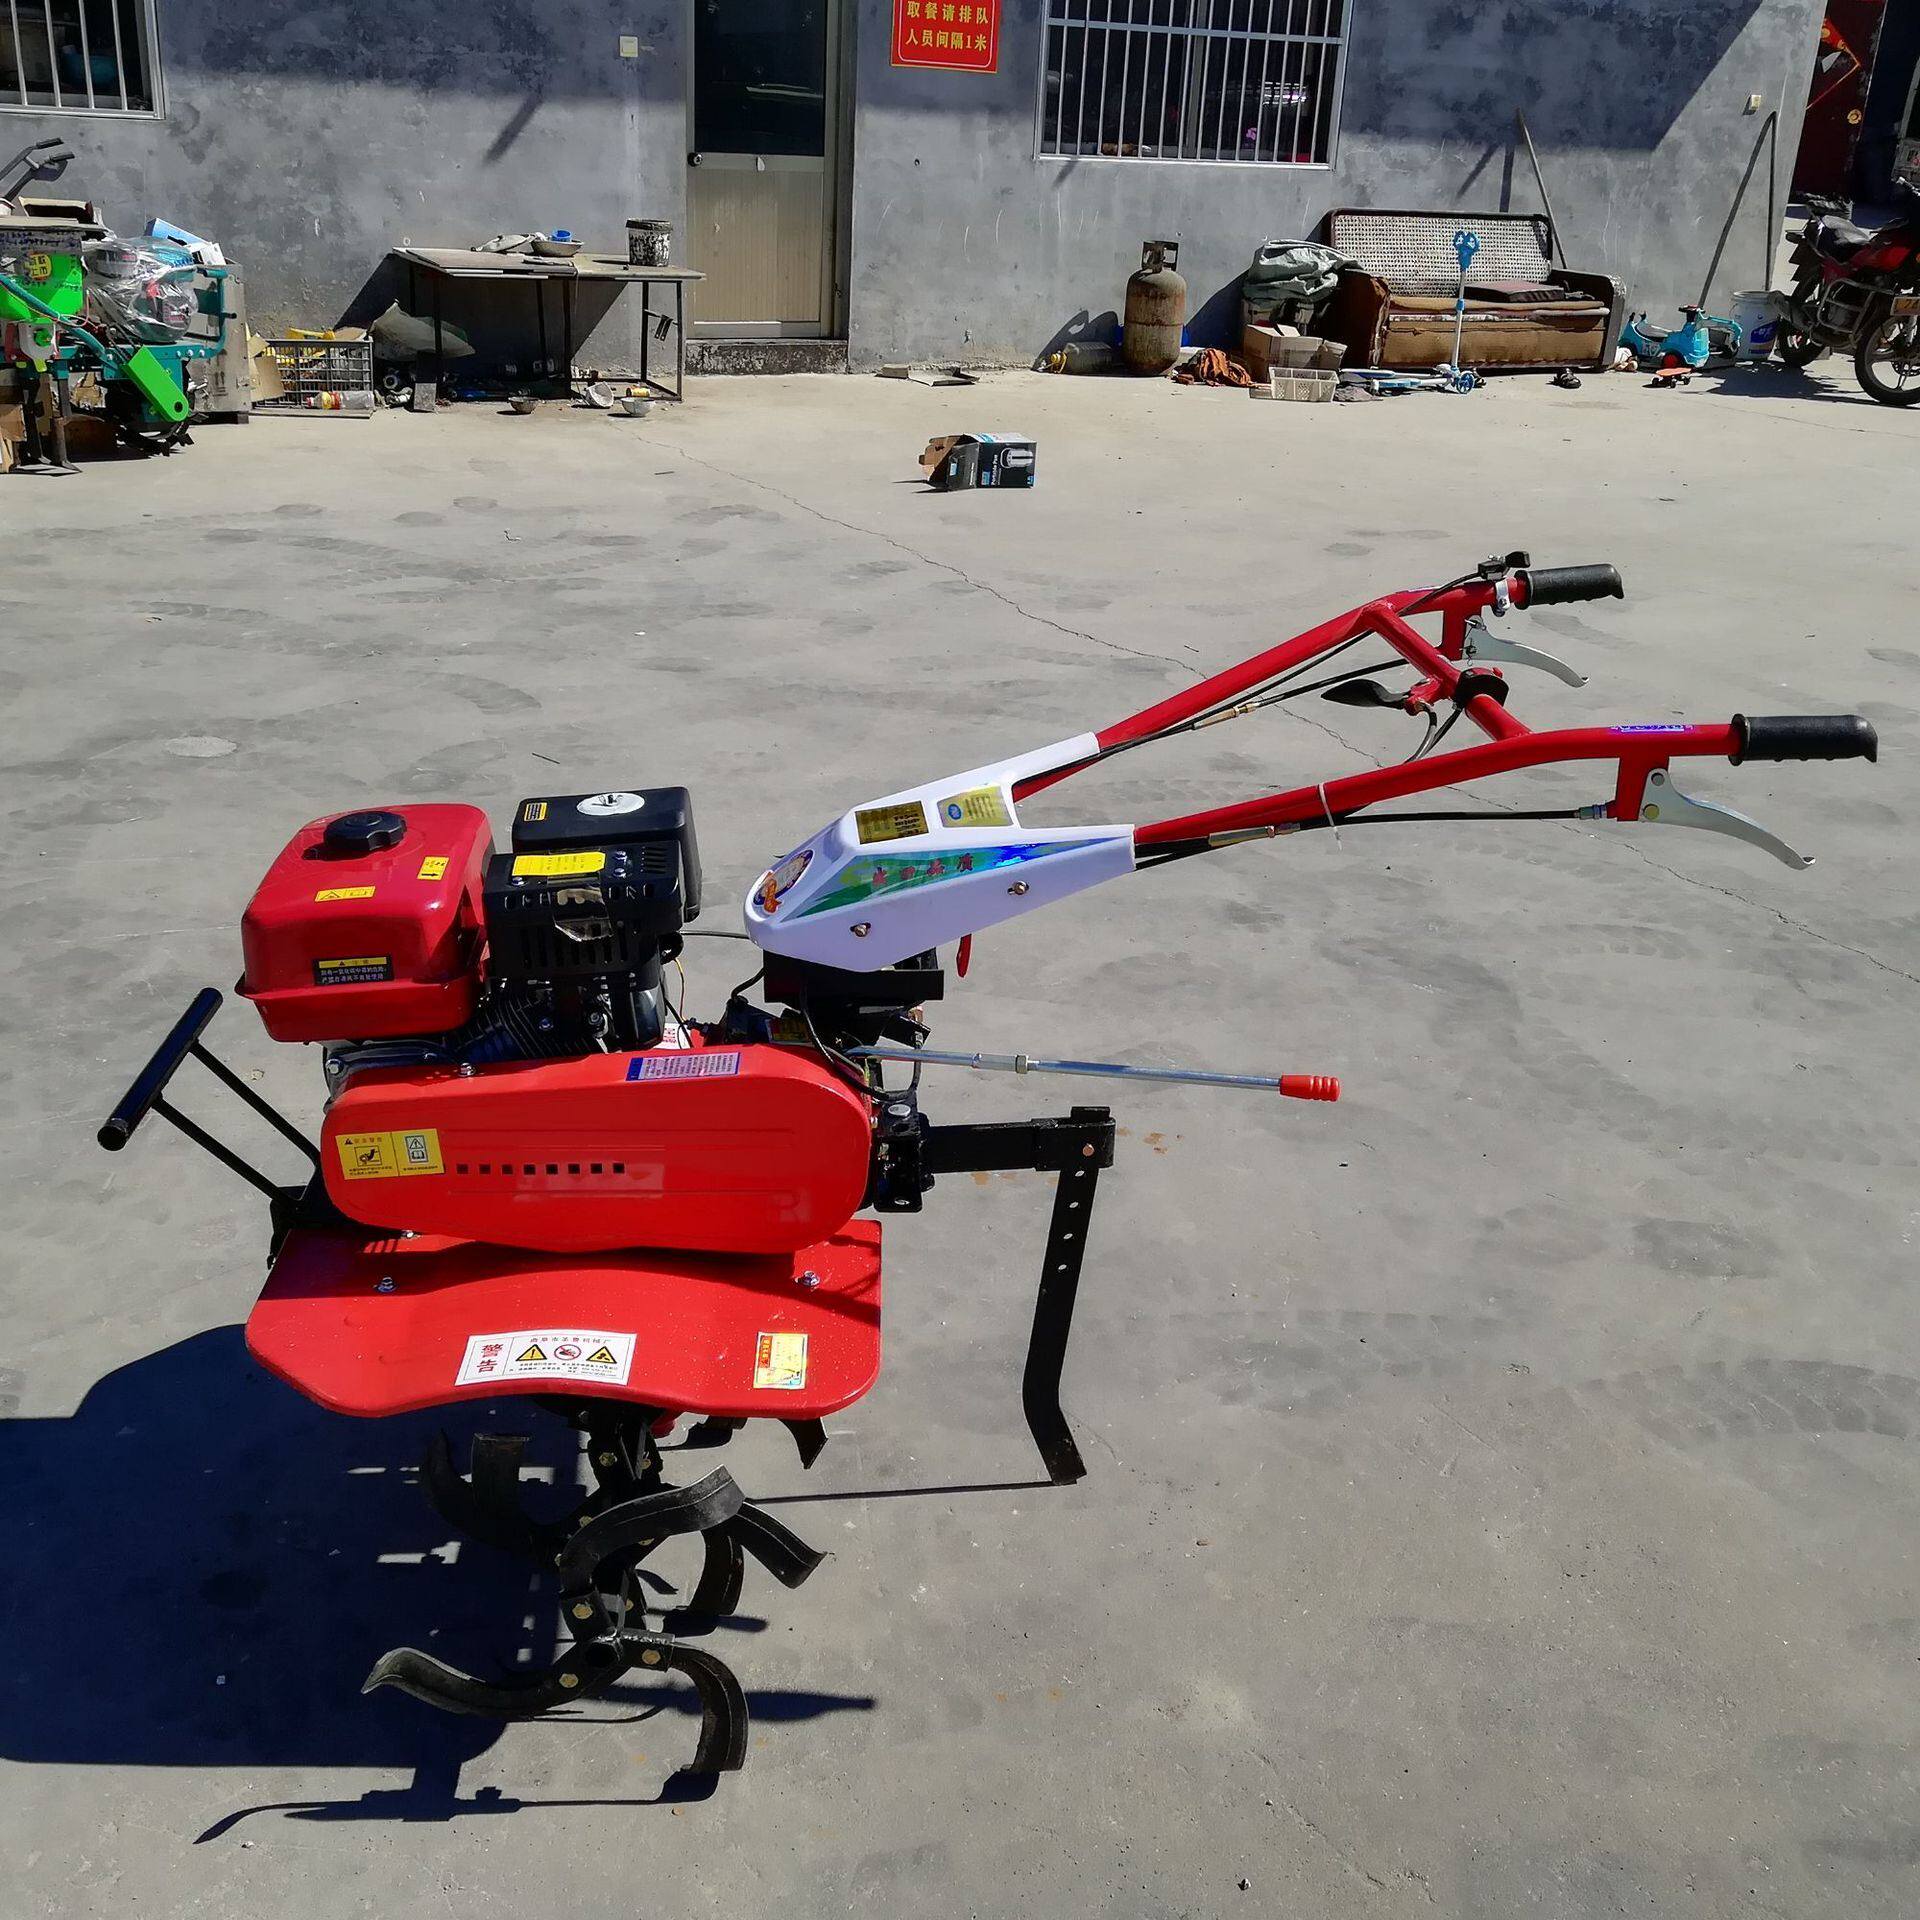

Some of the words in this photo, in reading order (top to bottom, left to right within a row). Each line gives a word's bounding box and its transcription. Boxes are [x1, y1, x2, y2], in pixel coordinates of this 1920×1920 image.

[907, 1, 988, 24] 取餐请排队
[905, 28, 987, 51] 人员间隔1米
[476, 1343, 504, 1373] 警告
